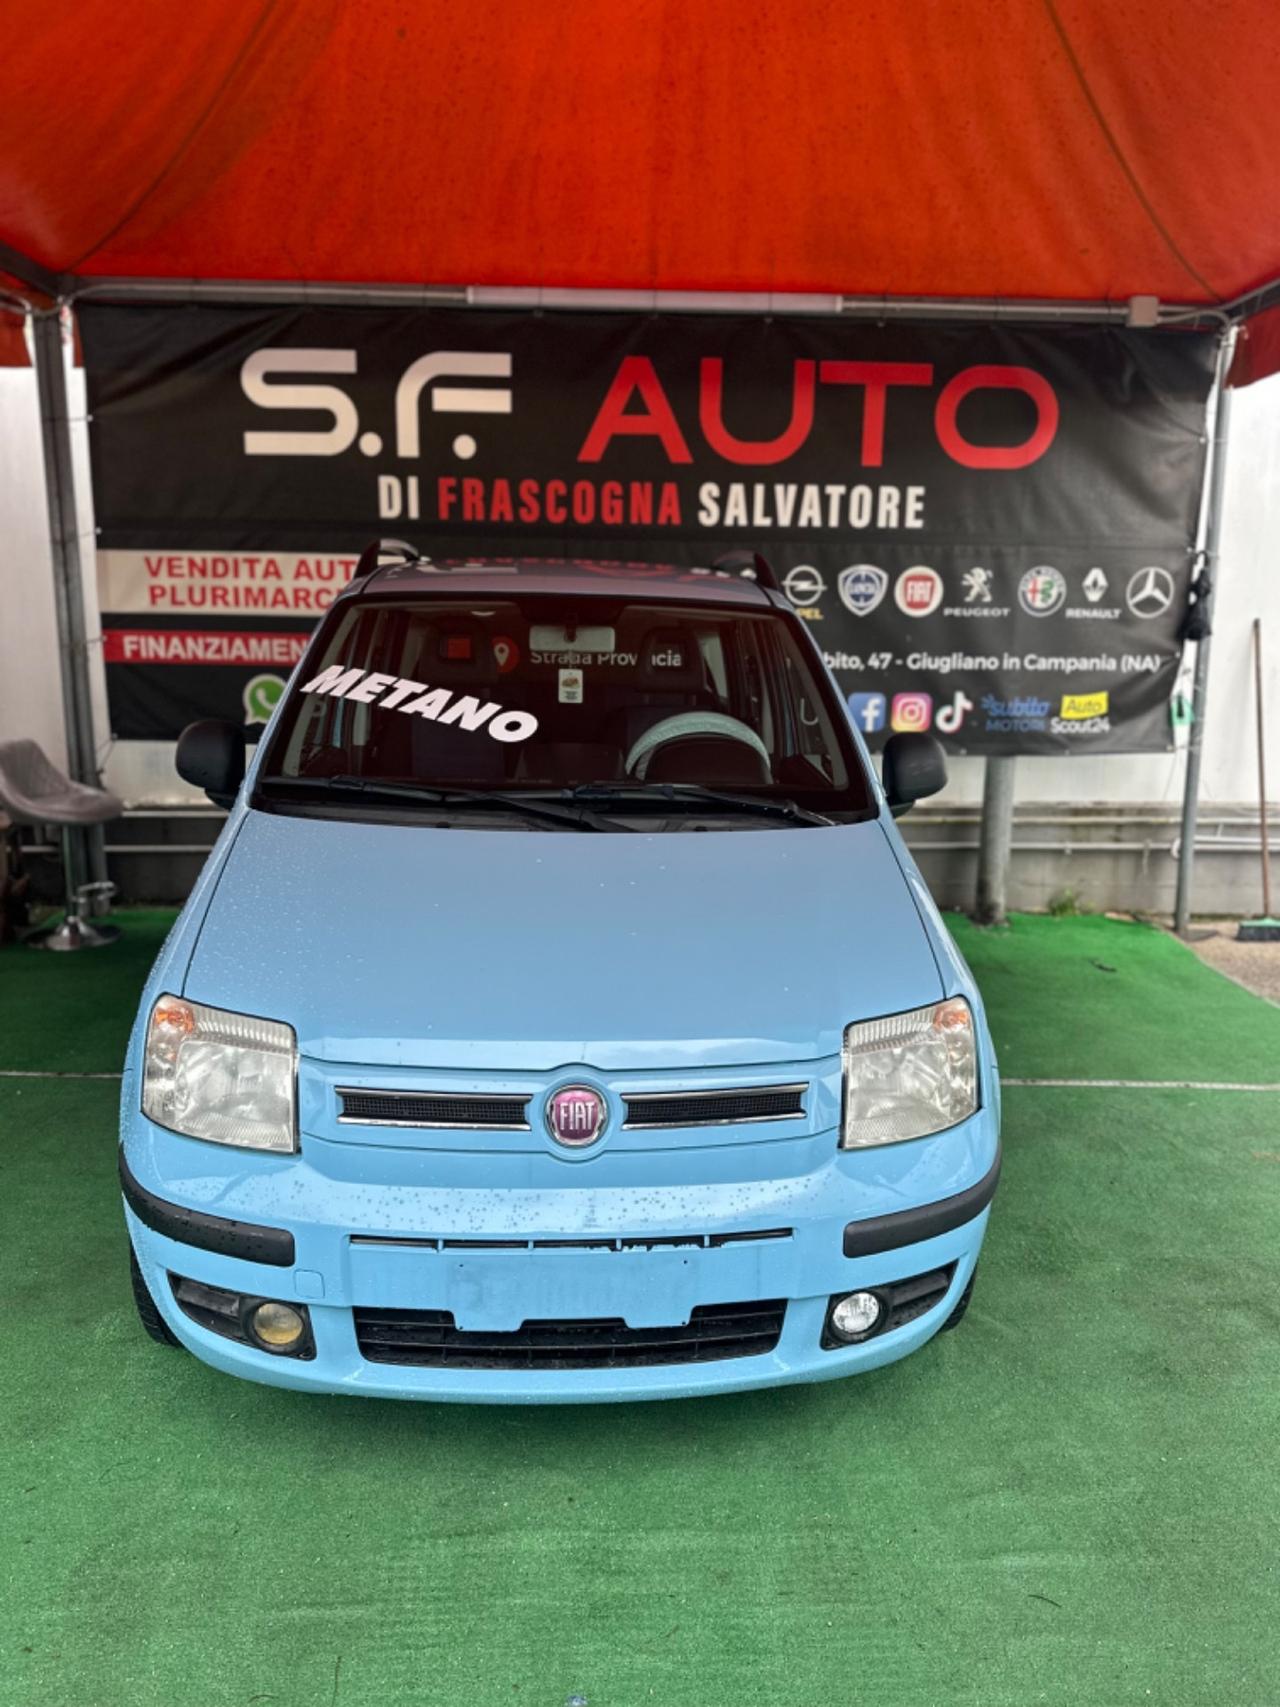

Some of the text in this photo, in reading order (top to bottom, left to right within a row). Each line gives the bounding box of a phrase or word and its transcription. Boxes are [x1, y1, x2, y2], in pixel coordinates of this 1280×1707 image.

[241, 347, 1060, 470] S.F. AUTO
[378, 475, 926, 529] DI FRASCOGNA SALVATORE
[145, 556, 357, 581] VENDITA AUT
[149, 585, 344, 610] PLURIMARC
[944, 607, 1010, 617] PEUGEOT
[1065, 608, 1121, 619] RENAULT
[122, 635, 309, 662] FINANZIAMEN
[598, 649, 682, 667] Provcia
[824, 651, 865, 671] bito,
[867, 652, 892, 670] 47
[906, 653, 999, 674] Giugliano
[1003, 652, 1020, 670] in
[1024, 653, 1117, 674] Campania
[1121, 654, 1160, 672] (NA)
[300, 665, 538, 742] METANO
[1066, 700, 1102, 713] Auto
[1050, 717, 1111, 734] Scout24
[560, 1101, 595, 1130] FIAT
